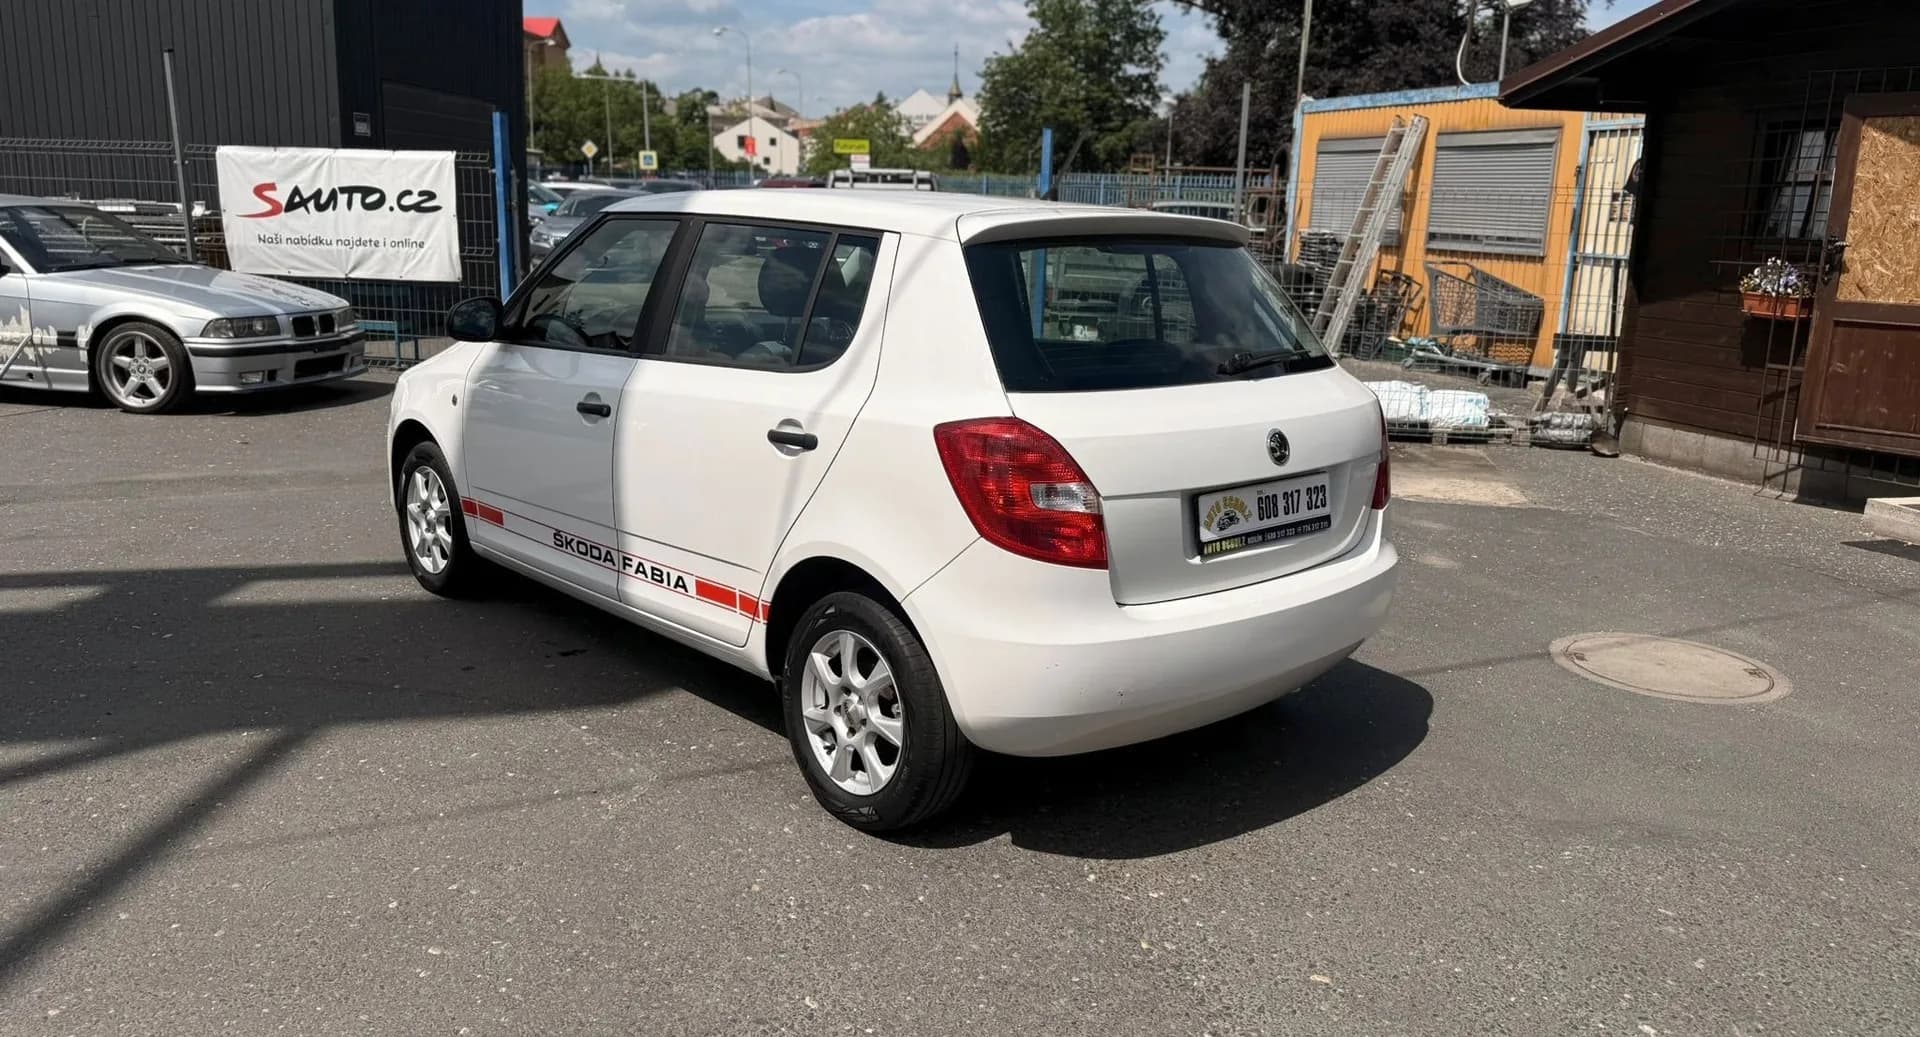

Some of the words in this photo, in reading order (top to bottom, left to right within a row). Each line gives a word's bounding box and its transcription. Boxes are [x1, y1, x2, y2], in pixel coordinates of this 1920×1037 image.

[257, 233, 282, 245] Naši
[286, 233, 333, 247] nabídku
[336, 236, 380, 250] najdete
[383, 236, 387, 248] i
[390, 237, 425, 249] online
[1257, 494, 1279, 521] 608
[1283, 489, 1301, 516] 317
[1306, 484, 1327, 511] 323
[553, 528, 616, 567] ŠKODA
[622, 555, 689, 593] FABIA
